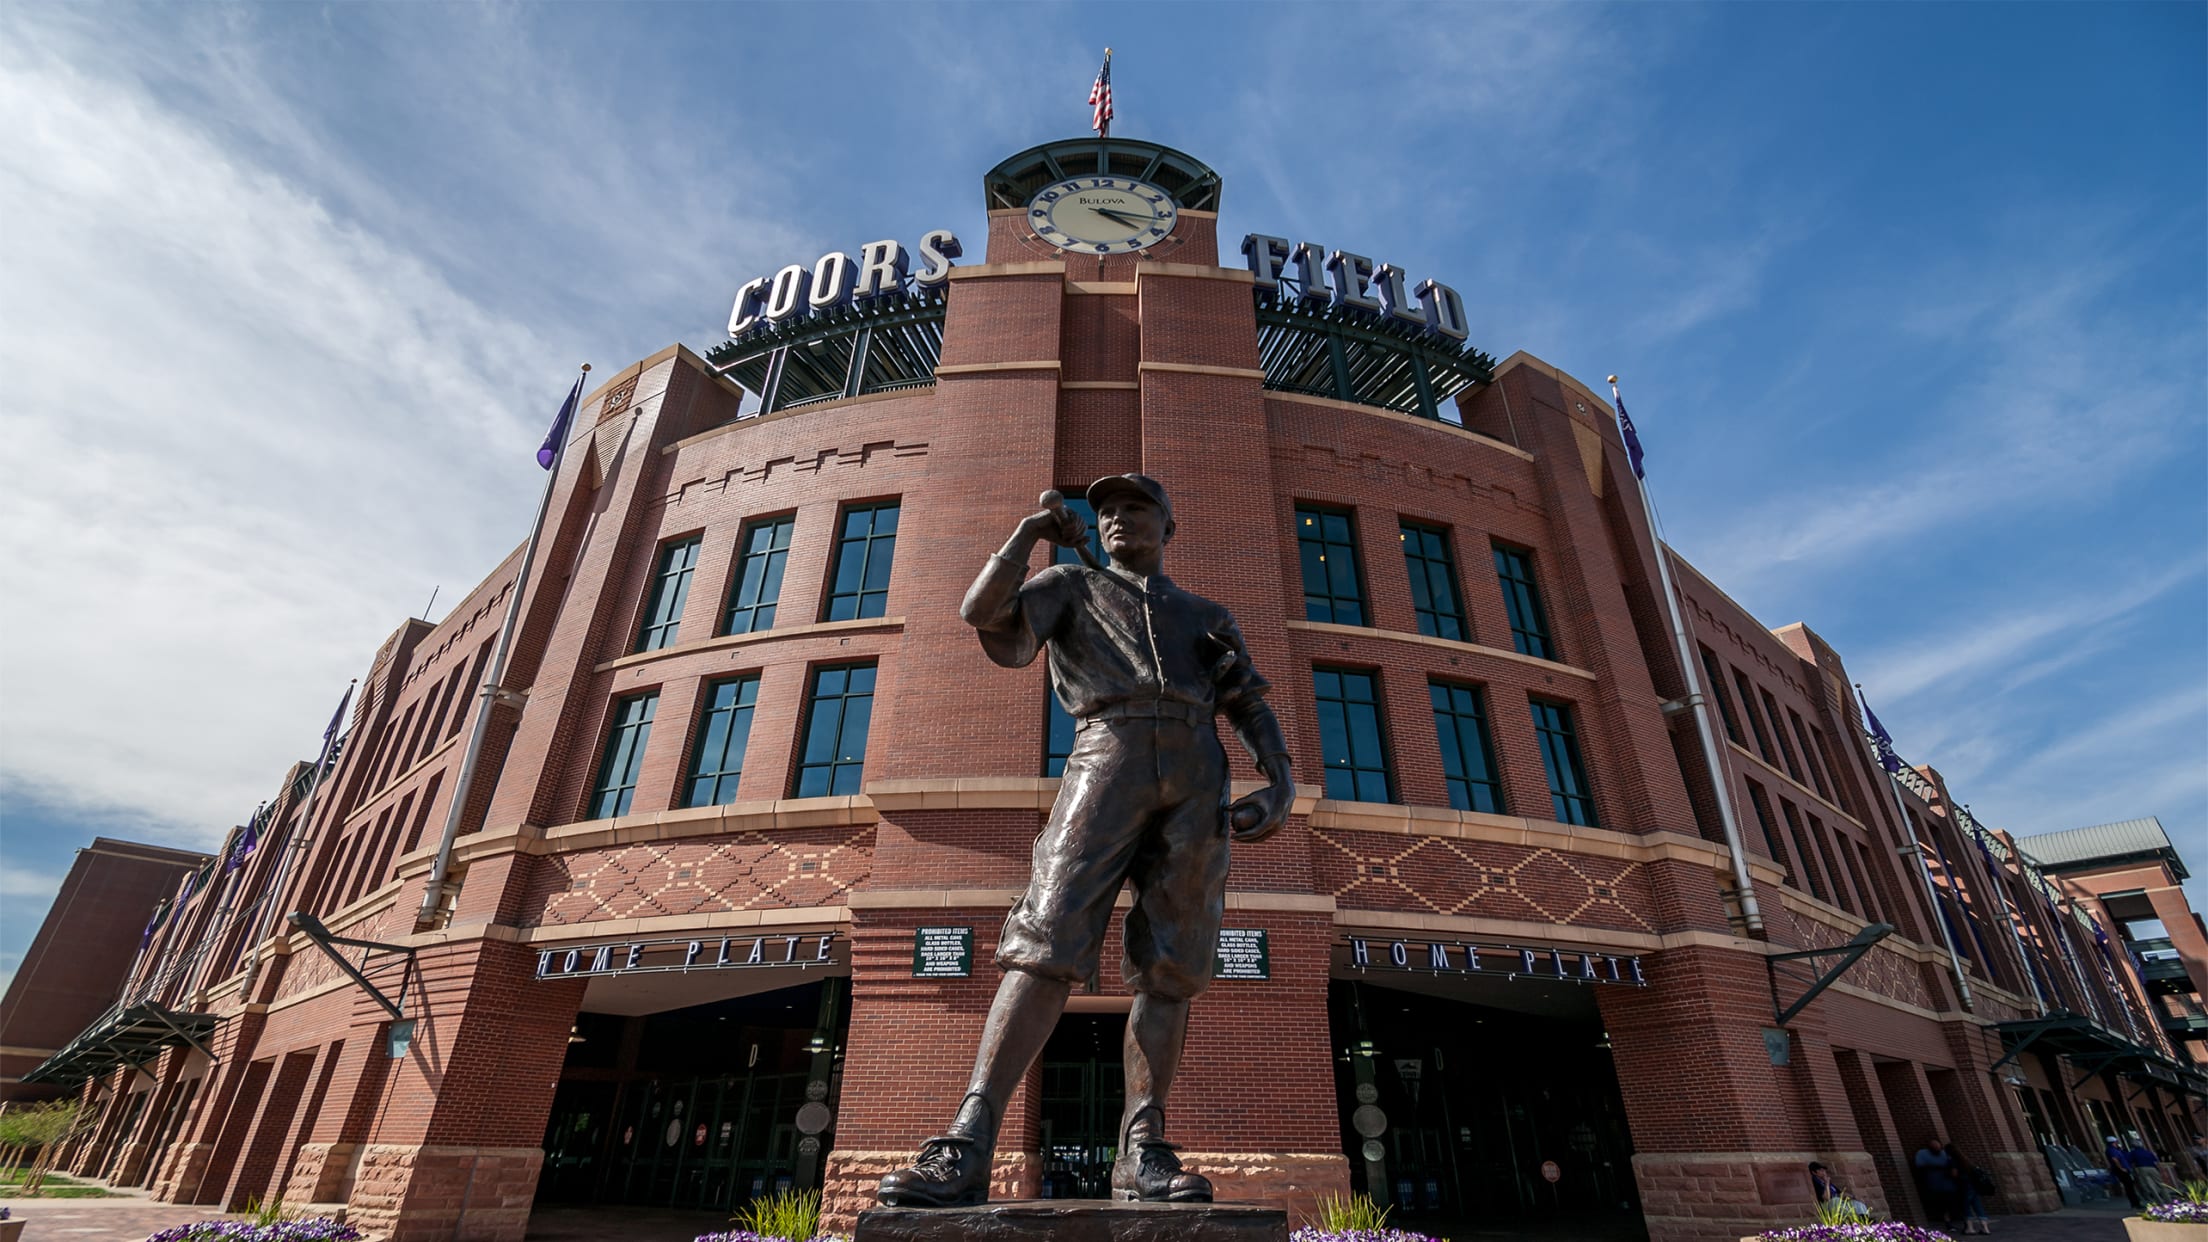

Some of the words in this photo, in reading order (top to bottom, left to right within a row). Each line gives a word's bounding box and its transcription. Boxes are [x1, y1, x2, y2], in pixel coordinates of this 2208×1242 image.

[1062, 182, 1081, 192] 11
[1091, 179, 1115, 188] 12
[1039, 191, 1059, 203] 10
[1146, 194, 1163, 204] 2
[1032, 209, 1047, 218] 9
[1039, 225, 1055, 235] 8
[1150, 227, 1164, 237] 4
[1062, 238, 1080, 247] 7
[1127, 238, 1142, 249] 5
[1095, 243, 1109, 253] 6
[727, 229, 962, 338] COORS
[1242, 233, 1470, 340] FIELD
[537, 944, 643, 977] HOME
[685, 936, 832, 965] PLATE
[1352, 940, 1481, 970] HOME
[1521, 950, 1645, 983] PLATE
[748, 1044, 758, 1069] D
